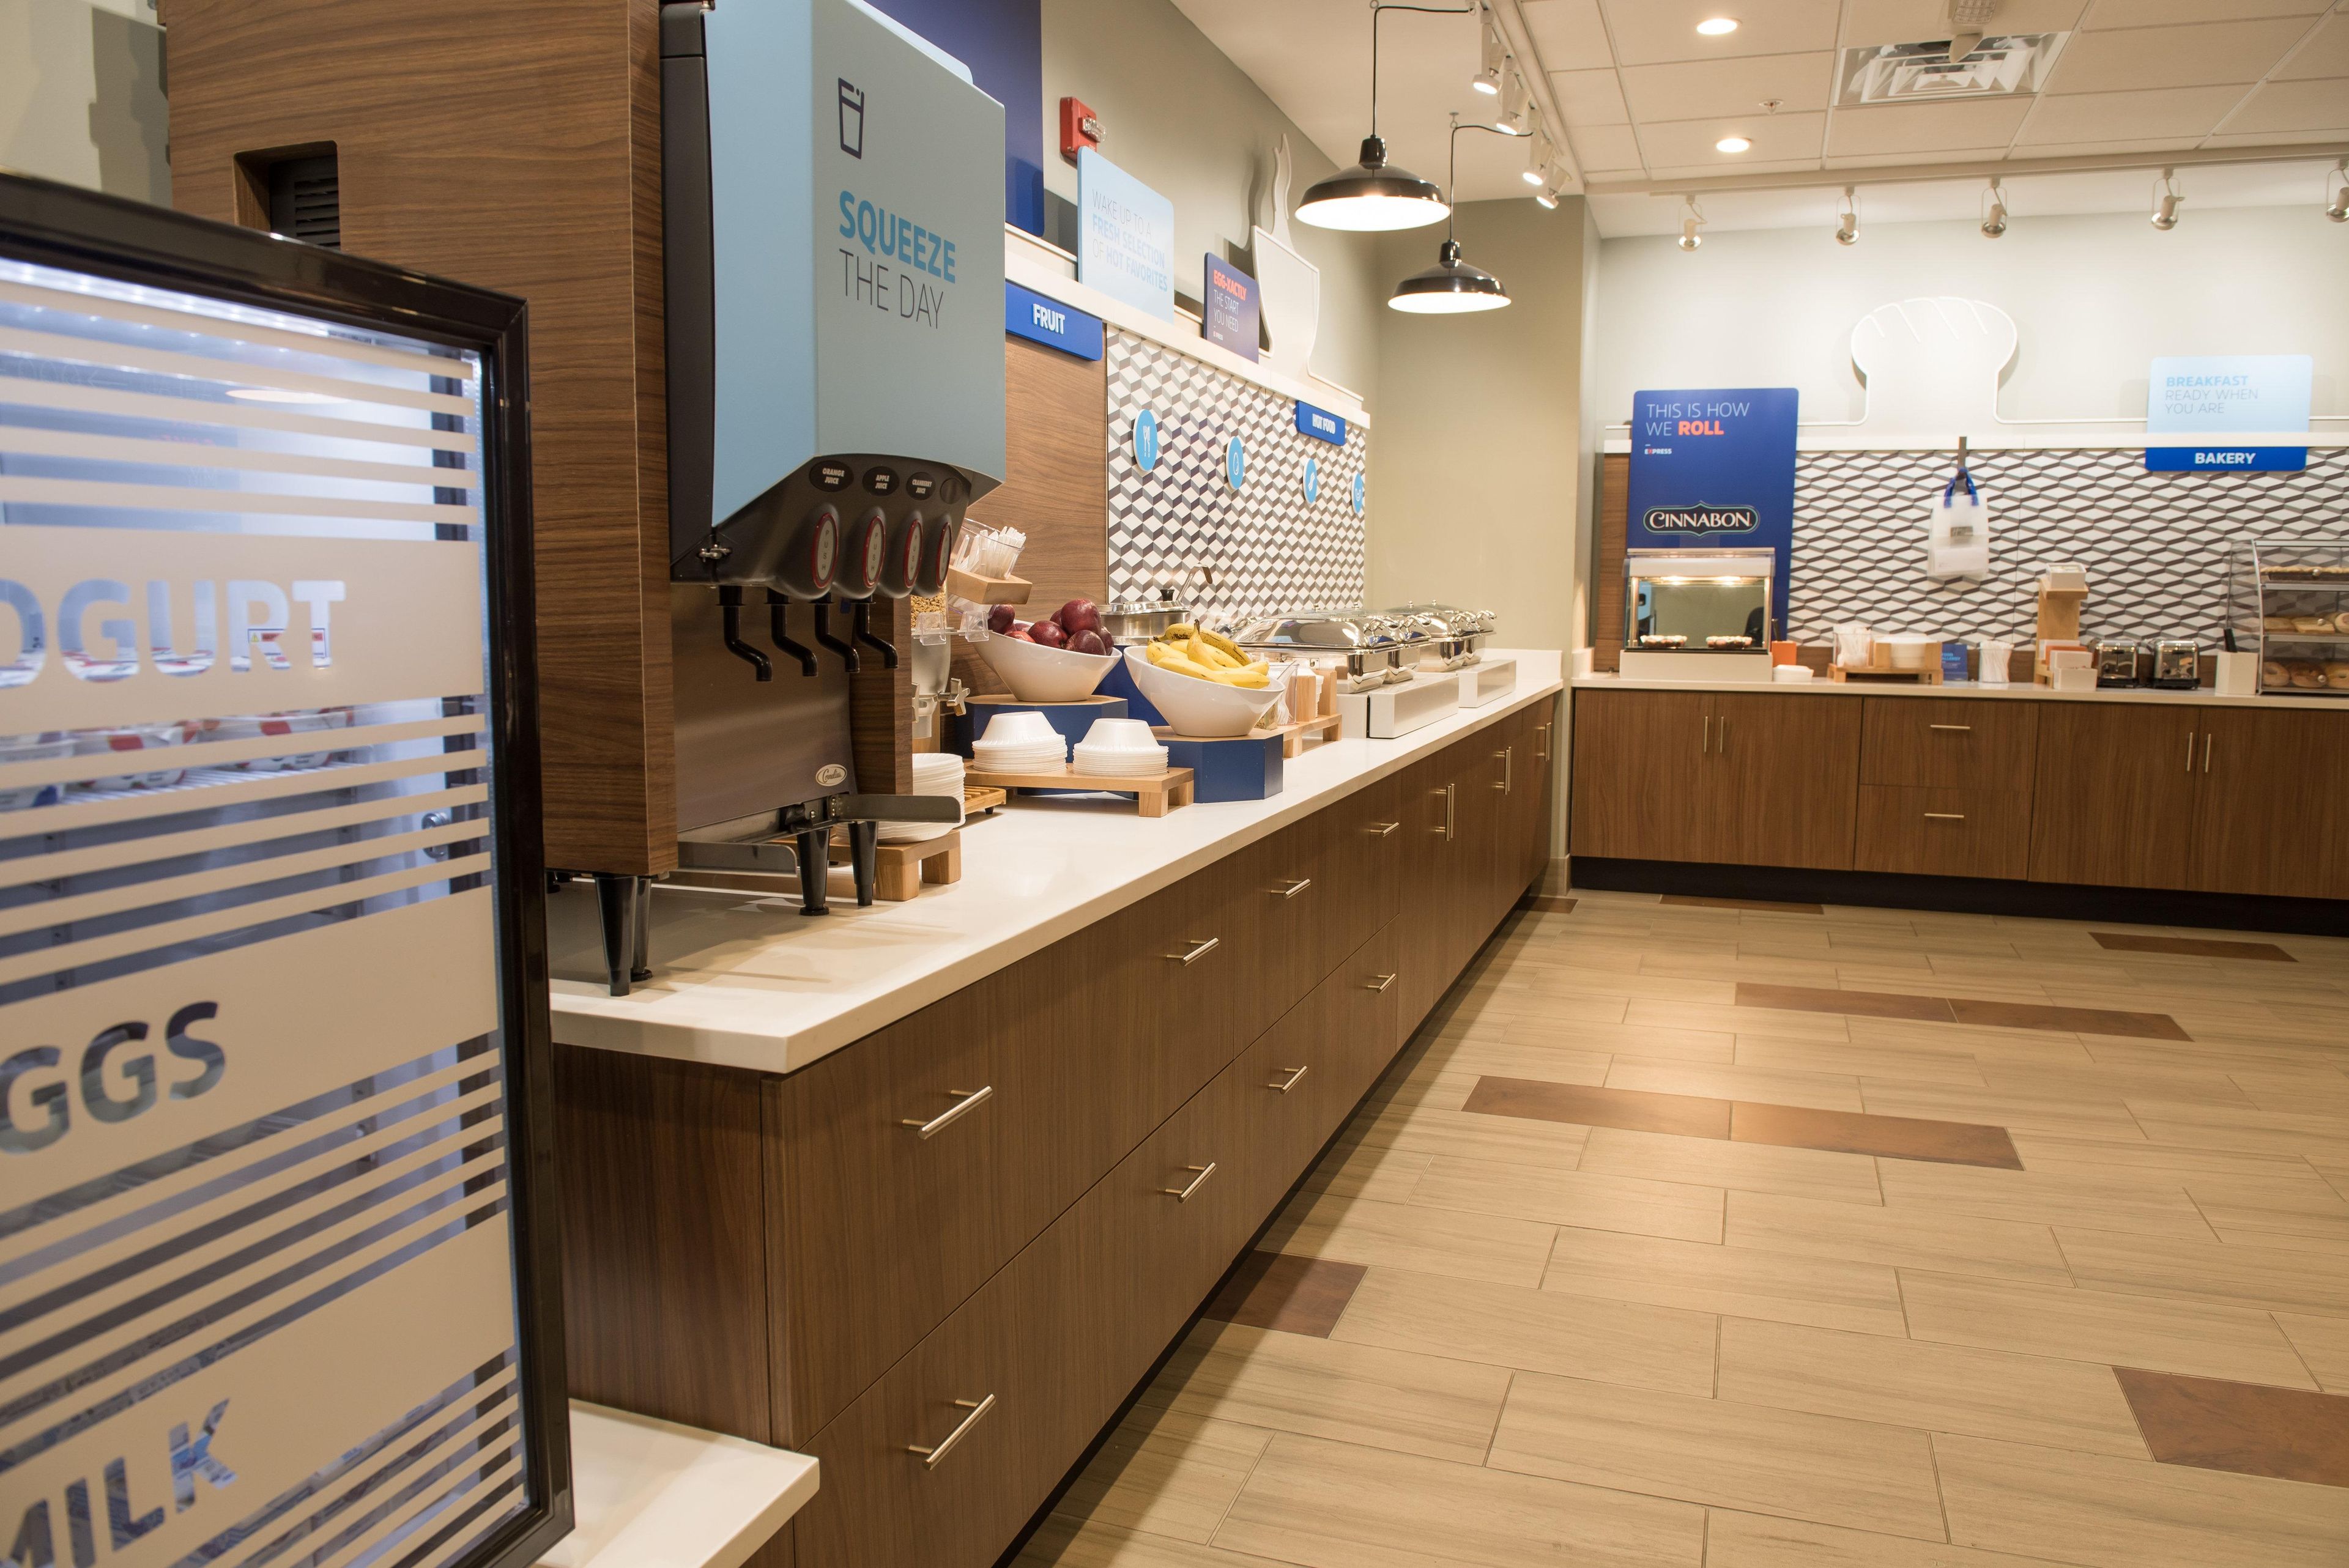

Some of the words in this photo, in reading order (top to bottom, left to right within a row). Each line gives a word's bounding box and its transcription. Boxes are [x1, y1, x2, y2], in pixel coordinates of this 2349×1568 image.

[1092, 188, 1118, 221] WAKE
[1119, 205, 1132, 226] UP
[1134, 213, 1144, 235] TO
[1146, 222, 1151, 240] A
[839, 190, 956, 284] SQUEEZE
[1092, 213, 1120, 245] FRESH
[1122, 231, 1165, 269] SELECTION
[1092, 239, 1104, 259] OF
[1106, 245, 1124, 270] HOT
[1126, 257, 1168, 292] FAVORITES
[839, 248, 889, 312] THE
[900, 273, 944, 330] DAY
[1213, 269, 1247, 301] EGG-XACTLY
[1213, 289, 1224, 308] THE
[1224, 295, 1239, 316] START
[1033, 303, 1065, 335] FRUIT
[1213, 308, 1225, 325] YOU
[1225, 314, 1239, 333] NEED
[2166, 375, 2249, 387] BREAKFAST
[2165, 389, 2211, 401] READY
[2216, 388, 2258, 400] WHEN
[1646, 403, 1682, 418] THIS
[1687, 403, 1701, 418] IS
[1707, 402, 1750, 418] HOW
[2165, 402, 2194, 415] YOU
[2198, 402, 2225, 414] ARE
[1646, 421, 1672, 436] WE
[1678, 420, 1724, 435] ROLL
[2195, 453, 2256, 464] BAKERY
[822, 467, 845, 477] ORANGE
[911, 479, 932, 487] CRANBERRY
[1649, 511, 1751, 529] CINNABON
[822, 530, 830, 571] PUSH
[870, 532, 879, 571] PUSH
